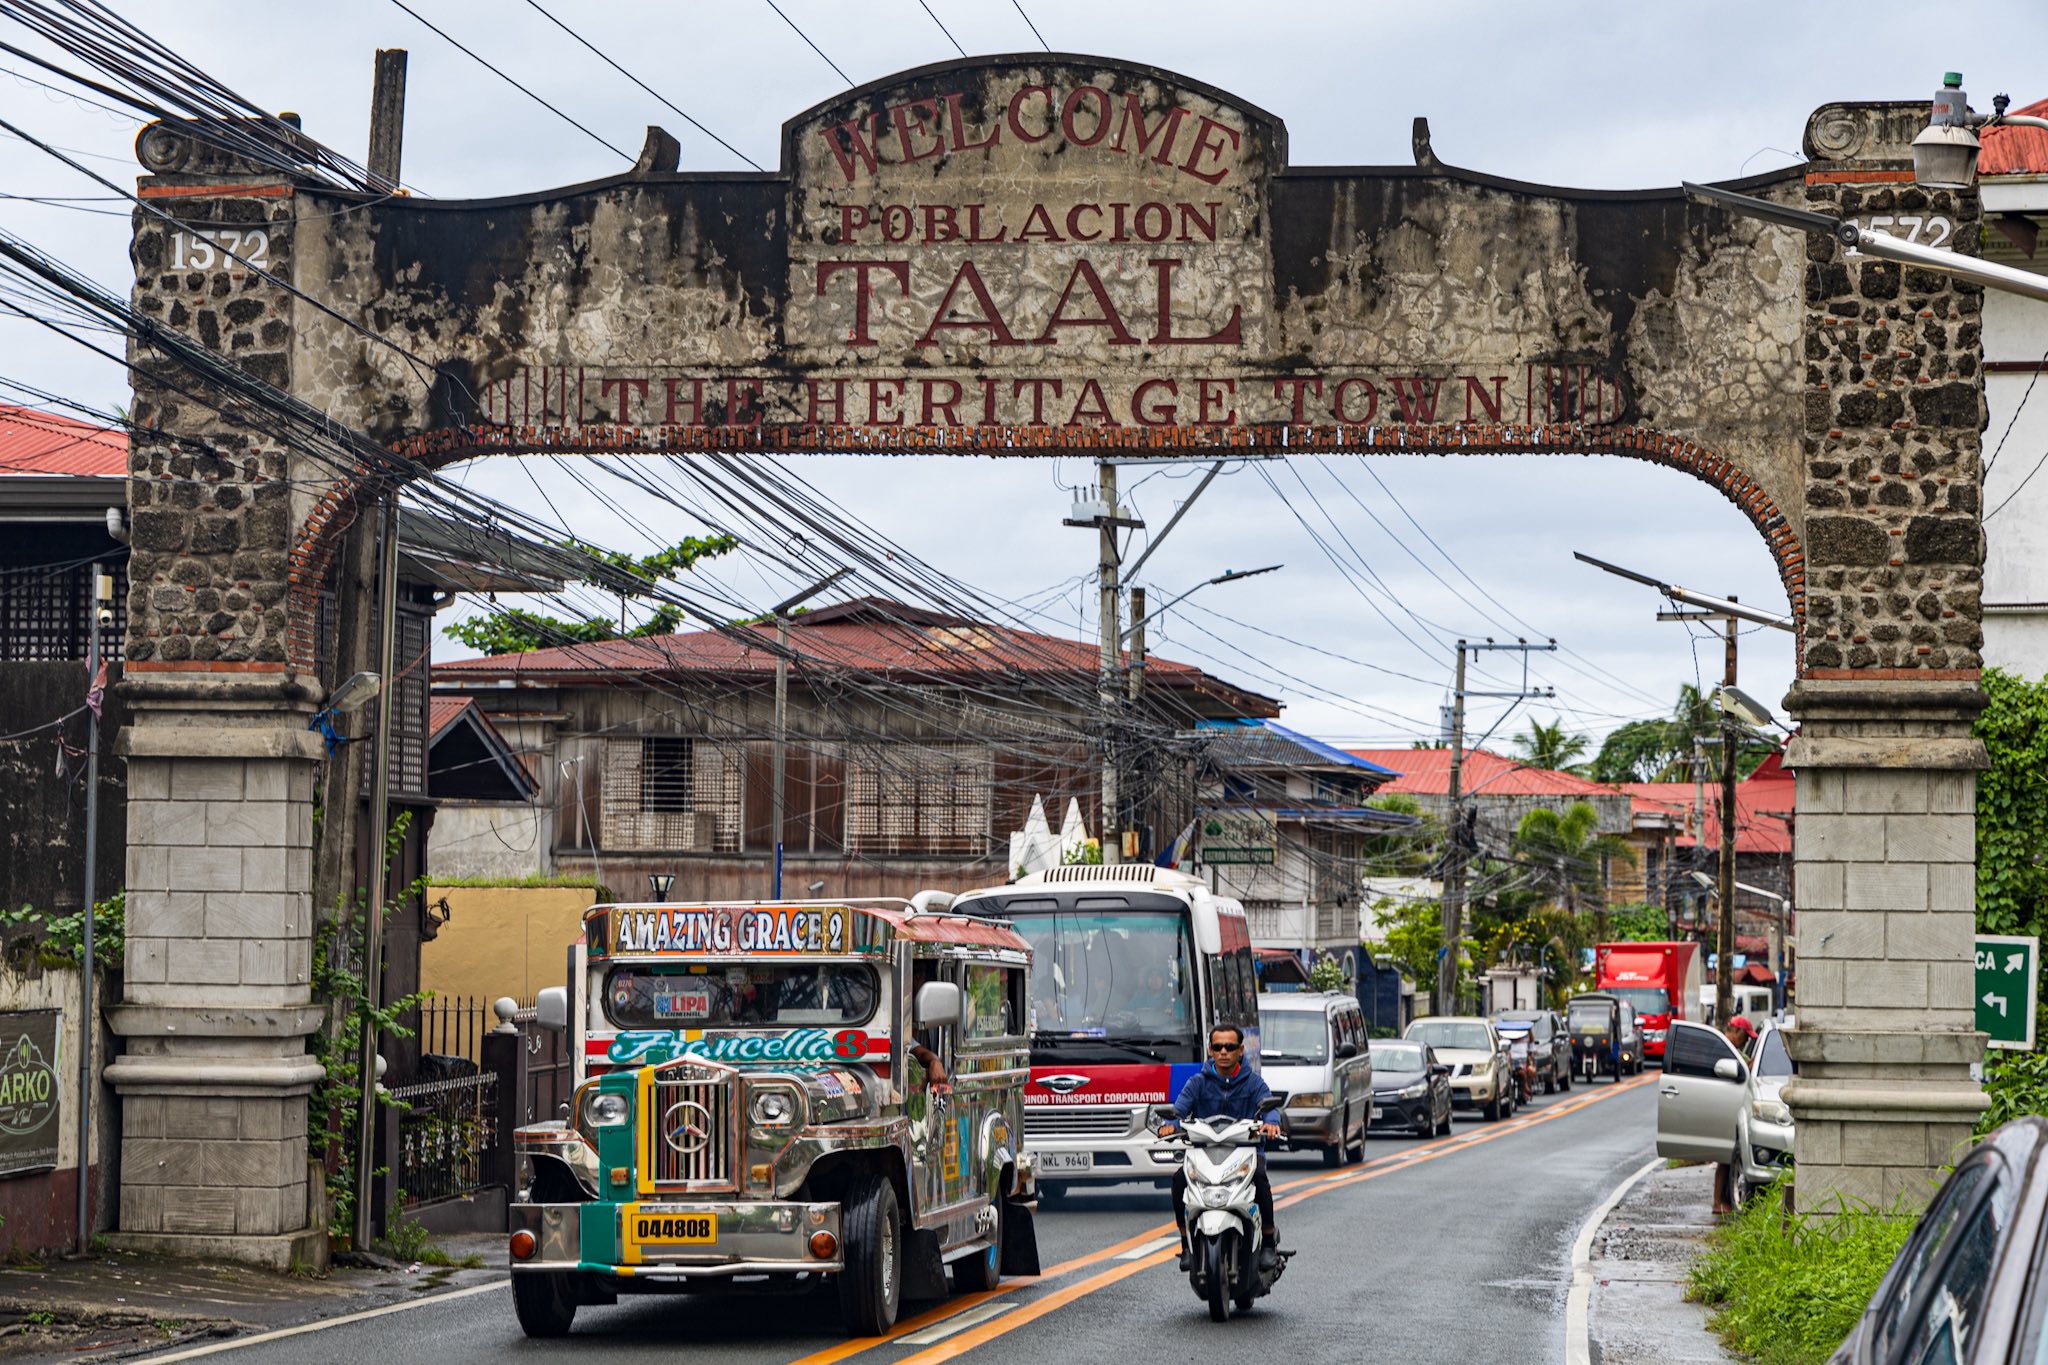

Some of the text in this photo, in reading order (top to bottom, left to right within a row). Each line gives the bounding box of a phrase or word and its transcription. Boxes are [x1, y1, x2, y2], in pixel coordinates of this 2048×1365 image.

[818, 85, 1241, 186] WELCOME
[837, 202, 1223, 245] POBLACION
[170, 229, 269, 269] 1572
[816, 258, 1242, 347] TAAL
[602, 376, 1509, 427] THE HERITAGE TOWN
[617, 912, 844, 951] AMAZING GRACE 2
[672, 995, 707, 1012] LIPA
[609, 1029, 868, 1062] Francella 3
[1051, 1093, 1102, 1104] TRANSPORT
[1104, 1092, 1166, 1102] CORPORATION
[1042, 1156, 1088, 1167] NKL 9640
[638, 1219, 710, 1238] 044808
